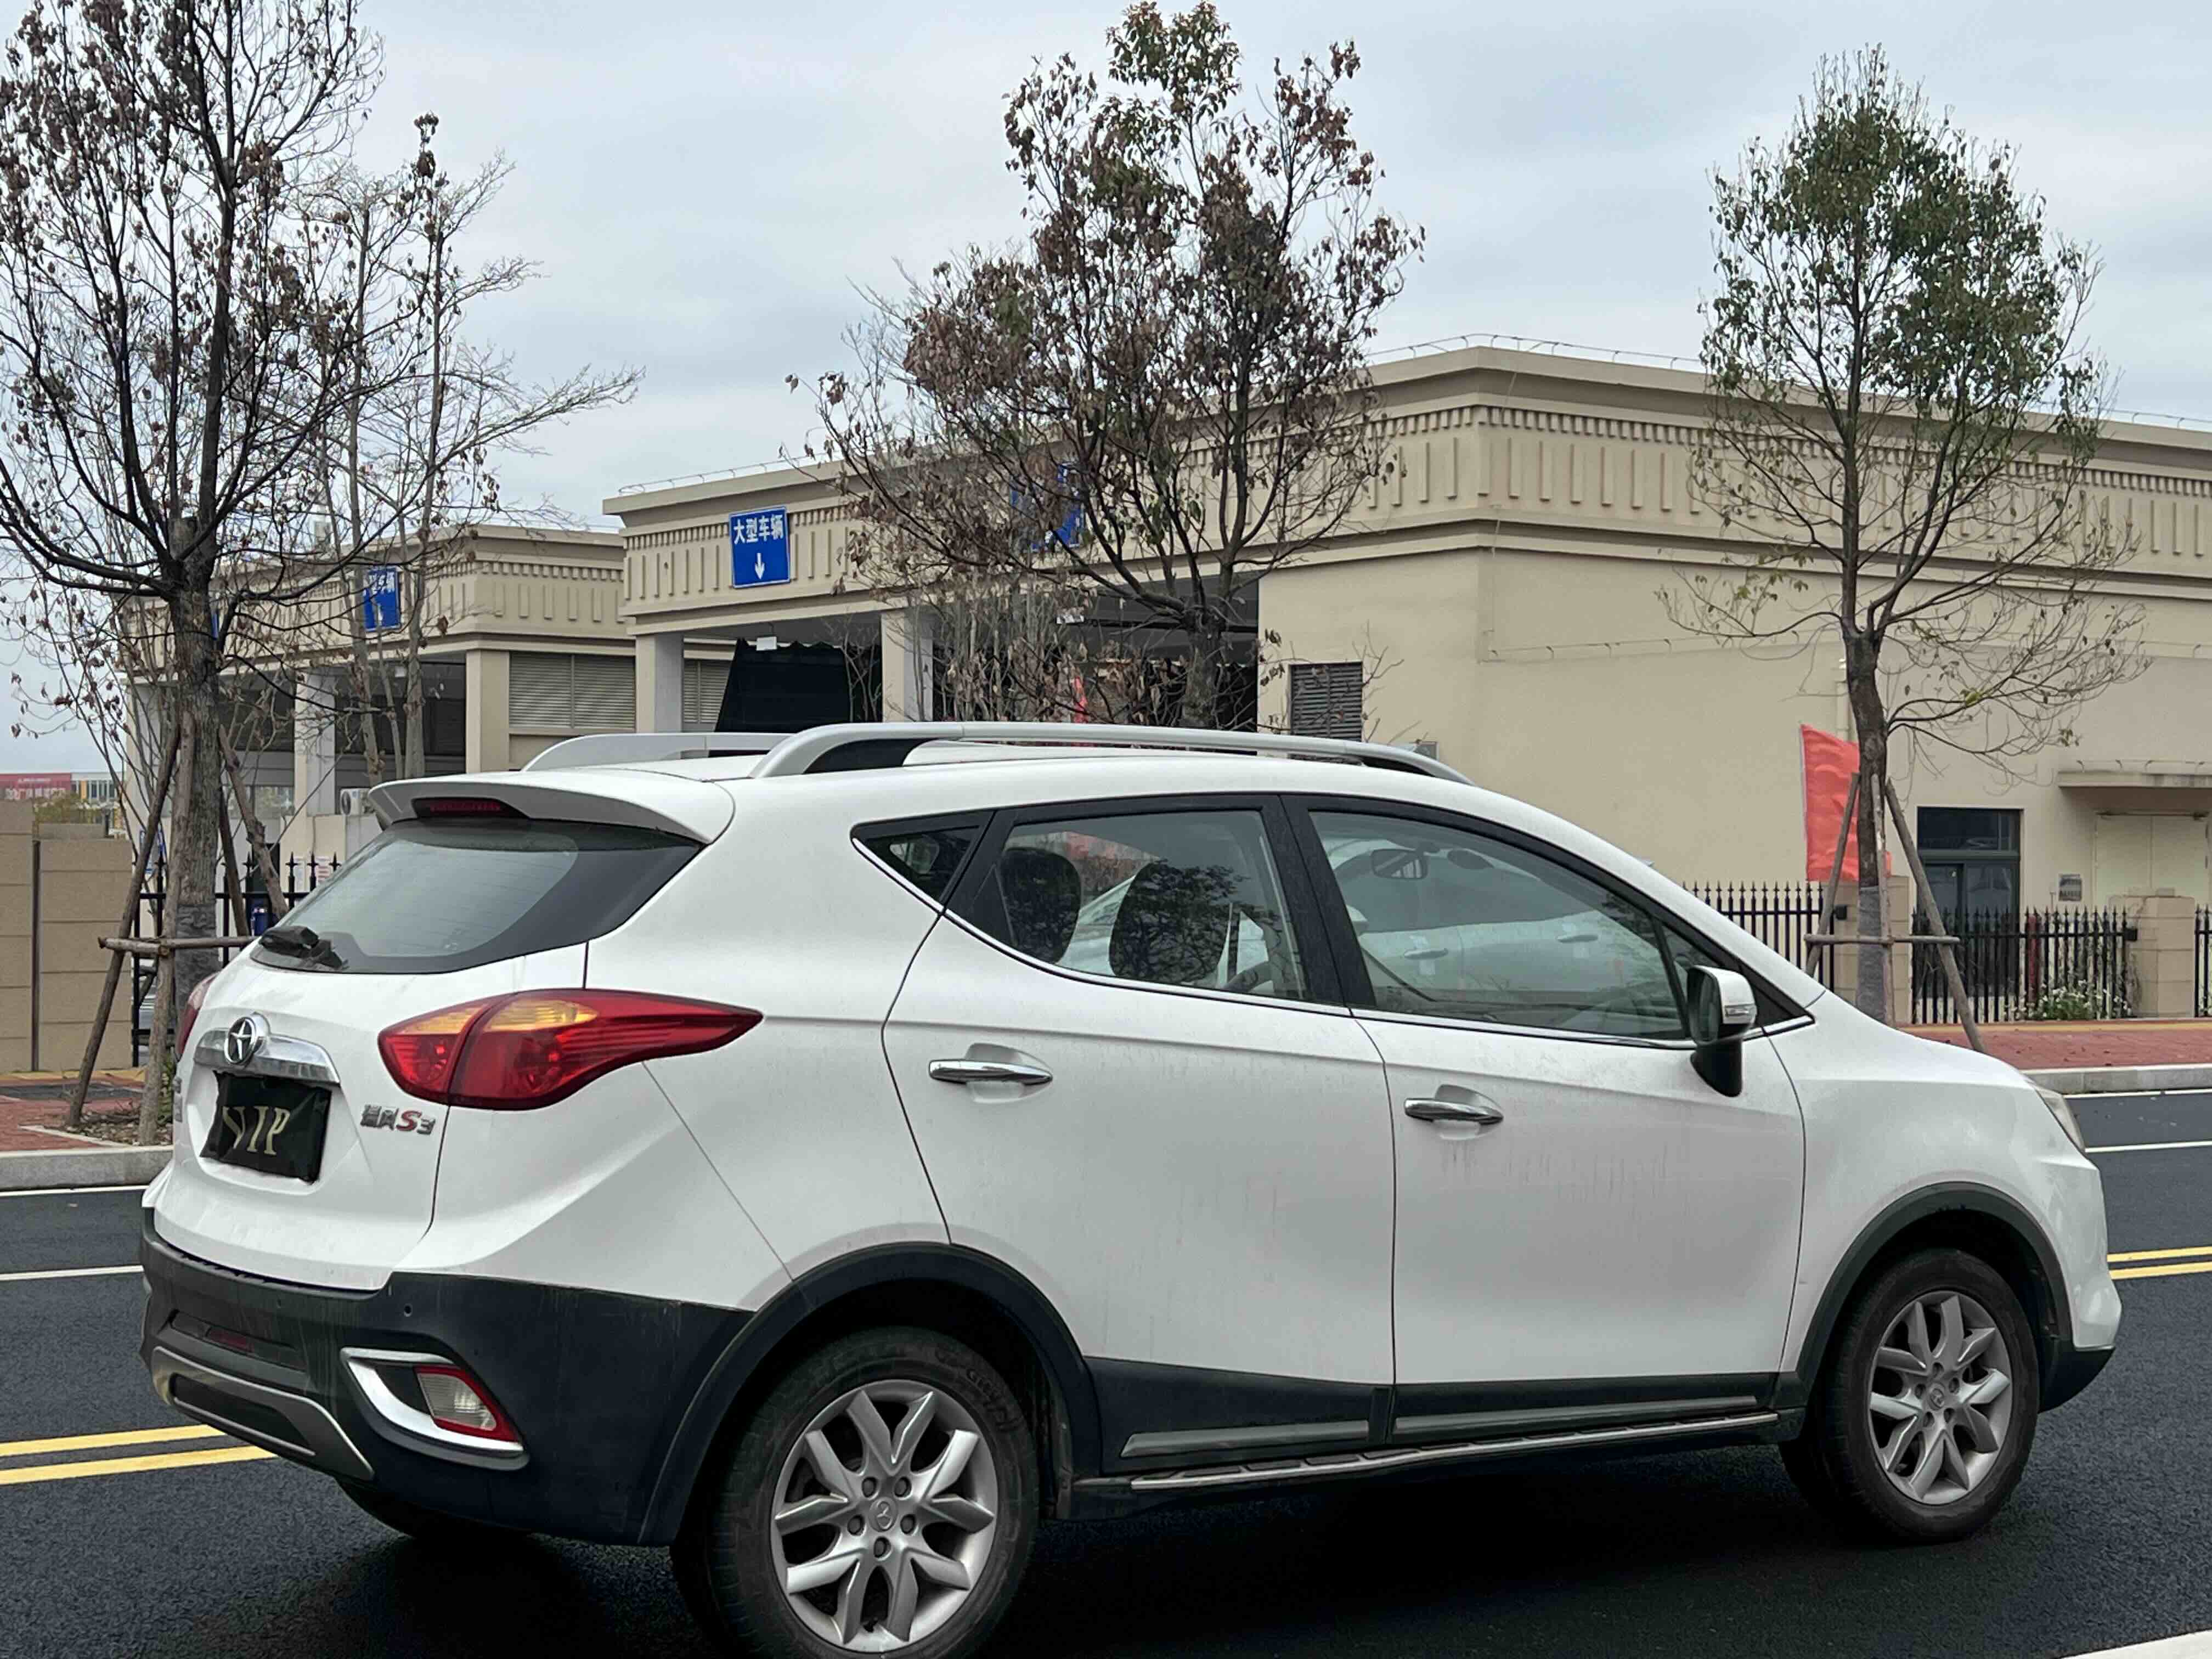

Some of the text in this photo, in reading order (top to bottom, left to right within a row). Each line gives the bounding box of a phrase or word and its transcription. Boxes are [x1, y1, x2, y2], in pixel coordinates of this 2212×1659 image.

[733, 514, 784, 544] 大型车辆
[222, 1105, 290, 1155] VIP
